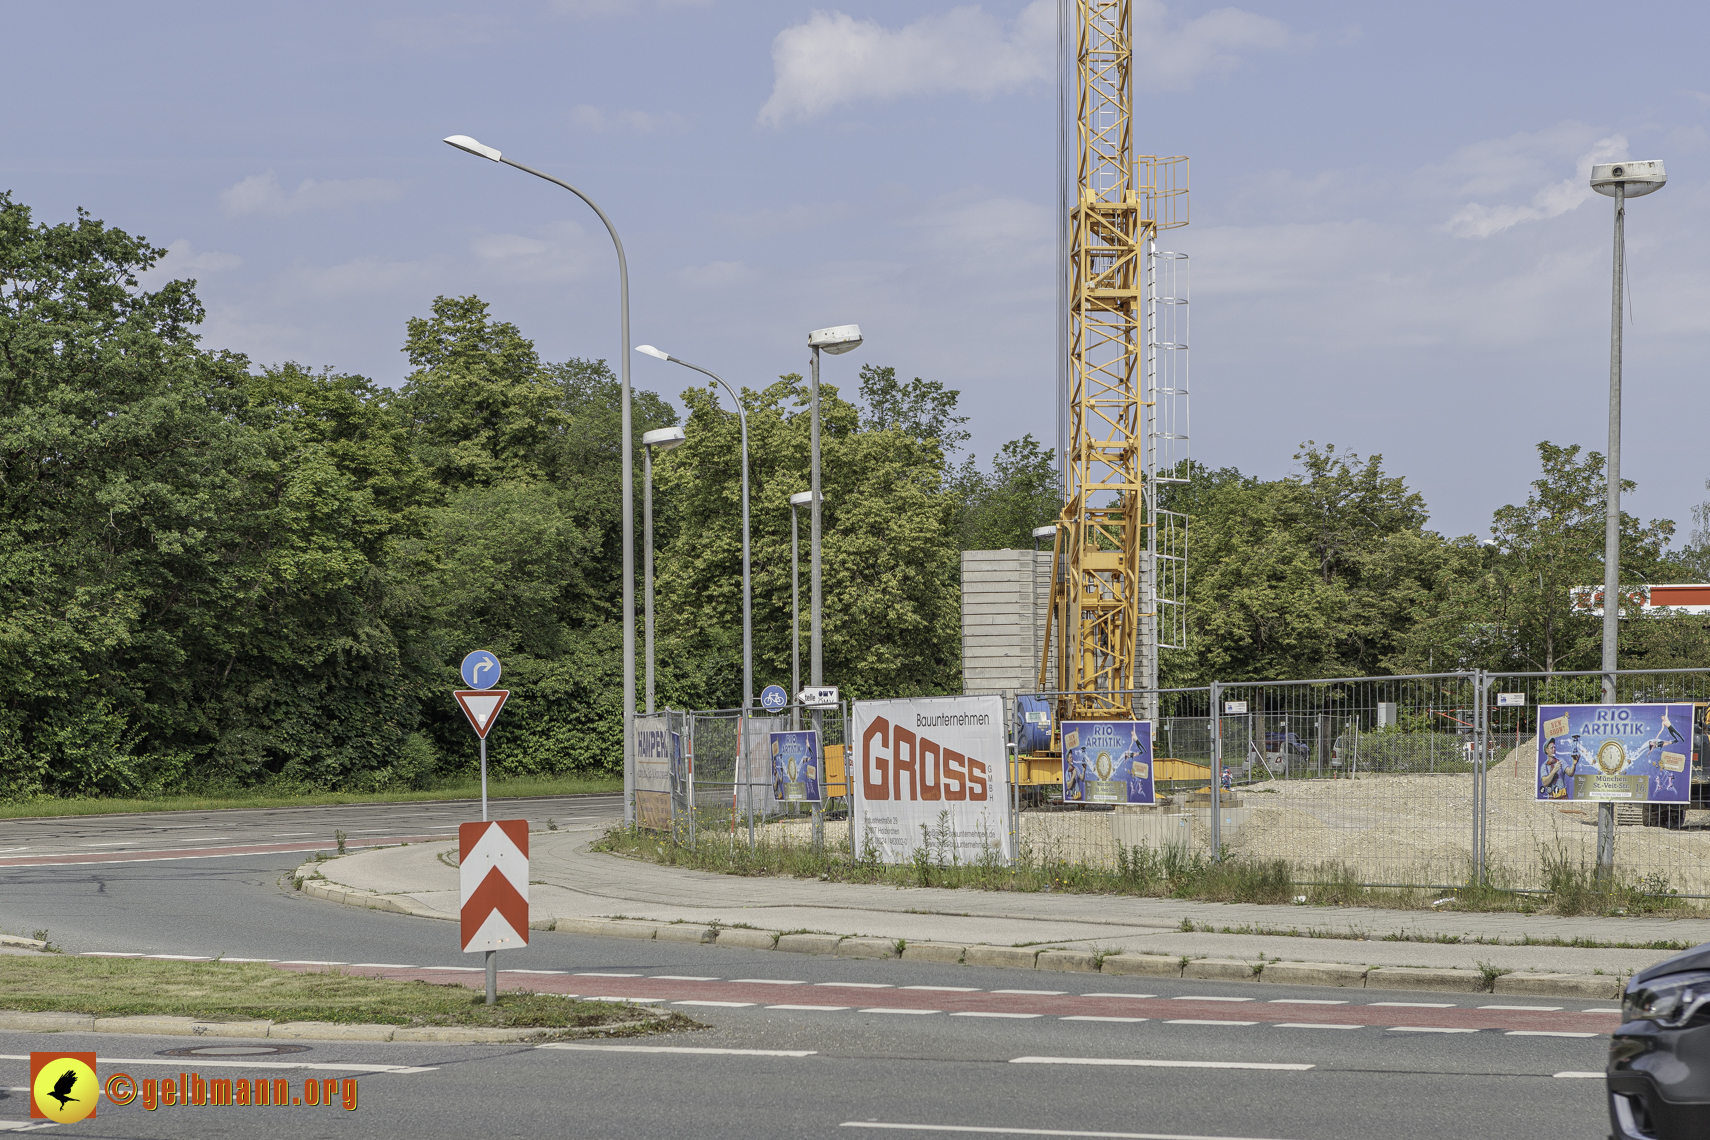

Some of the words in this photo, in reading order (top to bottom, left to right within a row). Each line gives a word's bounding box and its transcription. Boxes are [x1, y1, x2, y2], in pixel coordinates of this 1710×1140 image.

[916, 712, 990, 727] Bauunternehmen
[1597, 709, 1630, 721] RIO
[1094, 726, 1113, 735] RIO
[1582, 723, 1644, 736] ARTISTIK
[1086, 737, 1121, 747] ARTISTIK
[862, 715, 988, 802] GROSS
[1635, 784, 1646, 793] 16.
